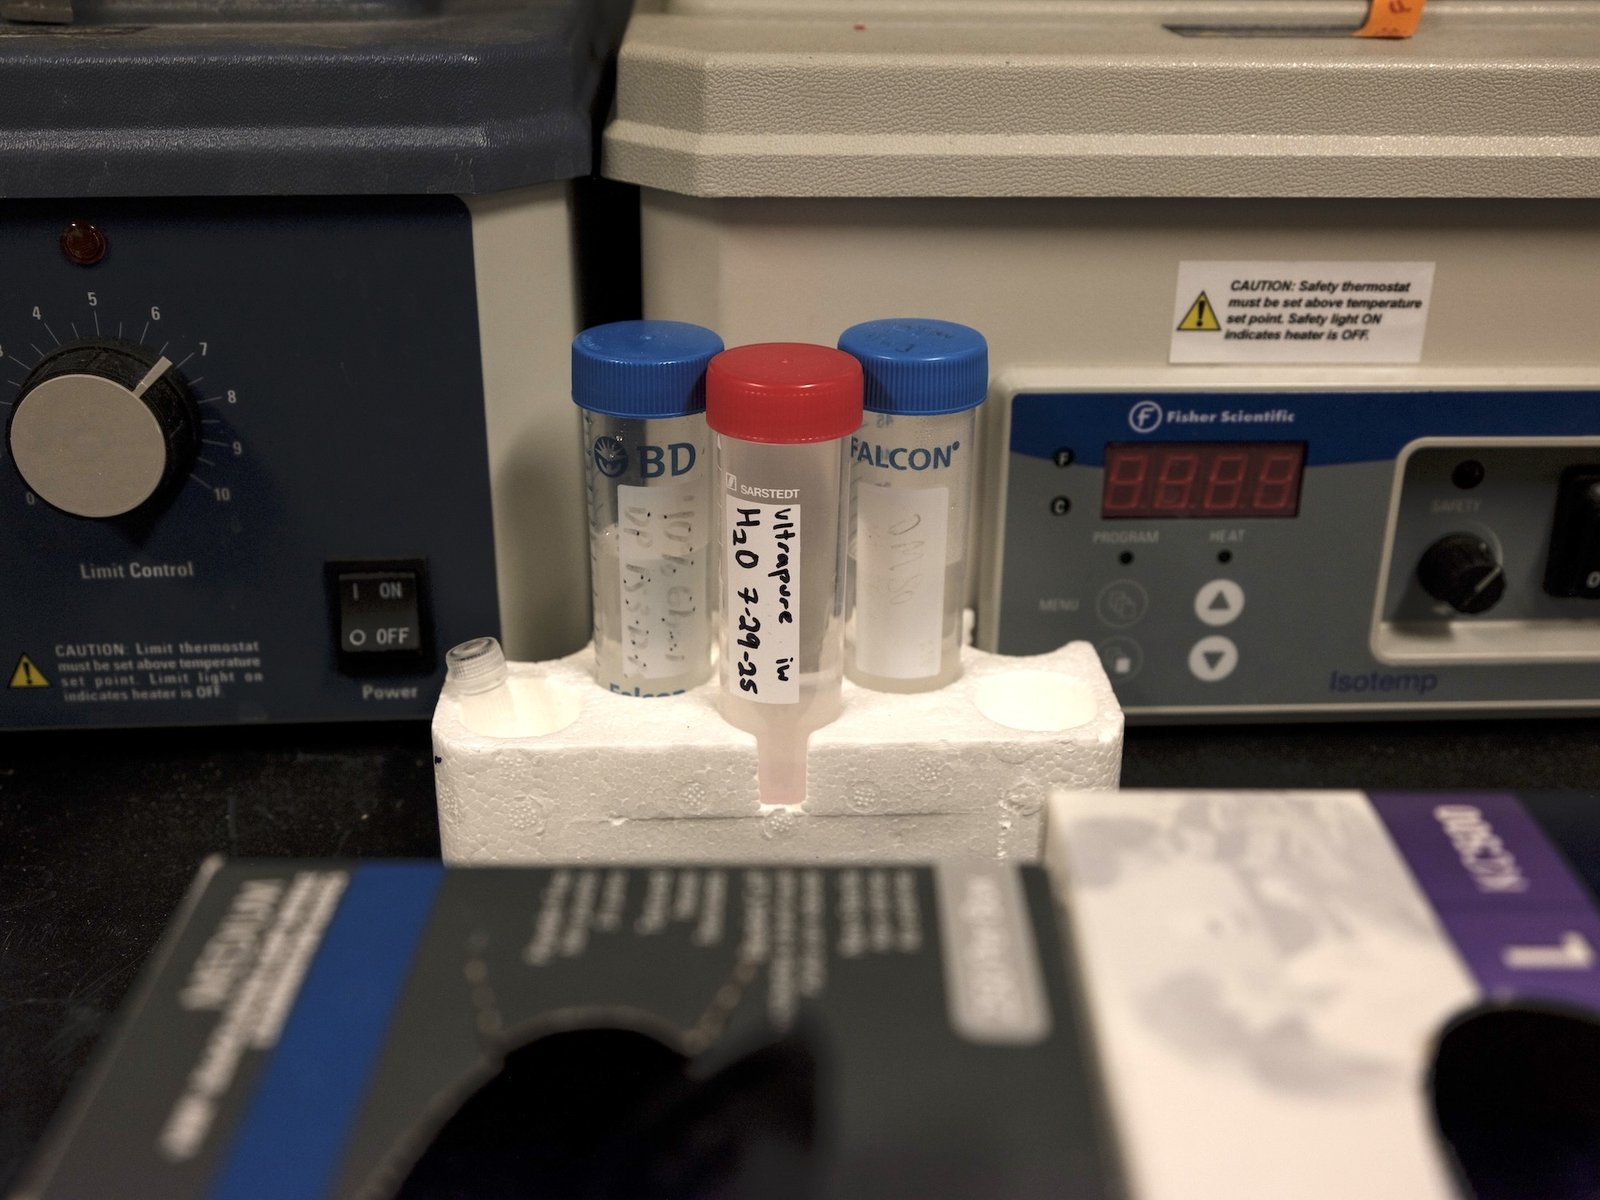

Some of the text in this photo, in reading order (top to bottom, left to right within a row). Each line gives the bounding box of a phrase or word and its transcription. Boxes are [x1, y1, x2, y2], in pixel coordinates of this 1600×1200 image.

[1231, 280, 1411, 295] CAUTION: Safety thermostat
[88, 292, 97, 306] 5
[1228, 297, 1422, 312] must be set above temperature
[32, 307, 42, 321] 4
[151, 306, 161, 321] 6
[1226, 313, 1382, 328] set point. Safety light ON
[1224, 329, 1281, 340] indicates
[1284, 330, 1325, 340] heater
[1327, 330, 1338, 340] is
[200, 342, 208, 356] 7
[227, 390, 237, 404] 8
[1166, 410, 1217, 423] Fisher
[1220, 410, 1296, 423] Scientific
[232, 441, 243, 455] 9
[851, 435, 952, 471] FALCON
[638, 441, 698, 479] BD
[213, 487, 230, 501] 10
[740, 485, 800, 499] SARSTEDT
[1209, 530, 1245, 542] HEAT
[81, 561, 194, 580] Limit Control
[379, 582, 403, 599] ON
[376, 628, 409, 645] OFF
[737, 587, 761, 694] 7-29-25
[135, 642, 173, 655] Limit
[179, 641, 260, 654] thermostat
[58, 657, 261, 672] must be set above temperature
[61, 675, 85, 687] set
[149, 672, 189, 685] Limit
[199, 671, 235, 687] light
[244, 672, 264, 683] on
[1329, 671, 1438, 695] Isotemp
[64, 690, 128, 702] indicates
[131, 688, 177, 701] heater
[181, 687, 193, 699] is
[362, 684, 418, 700] Power
